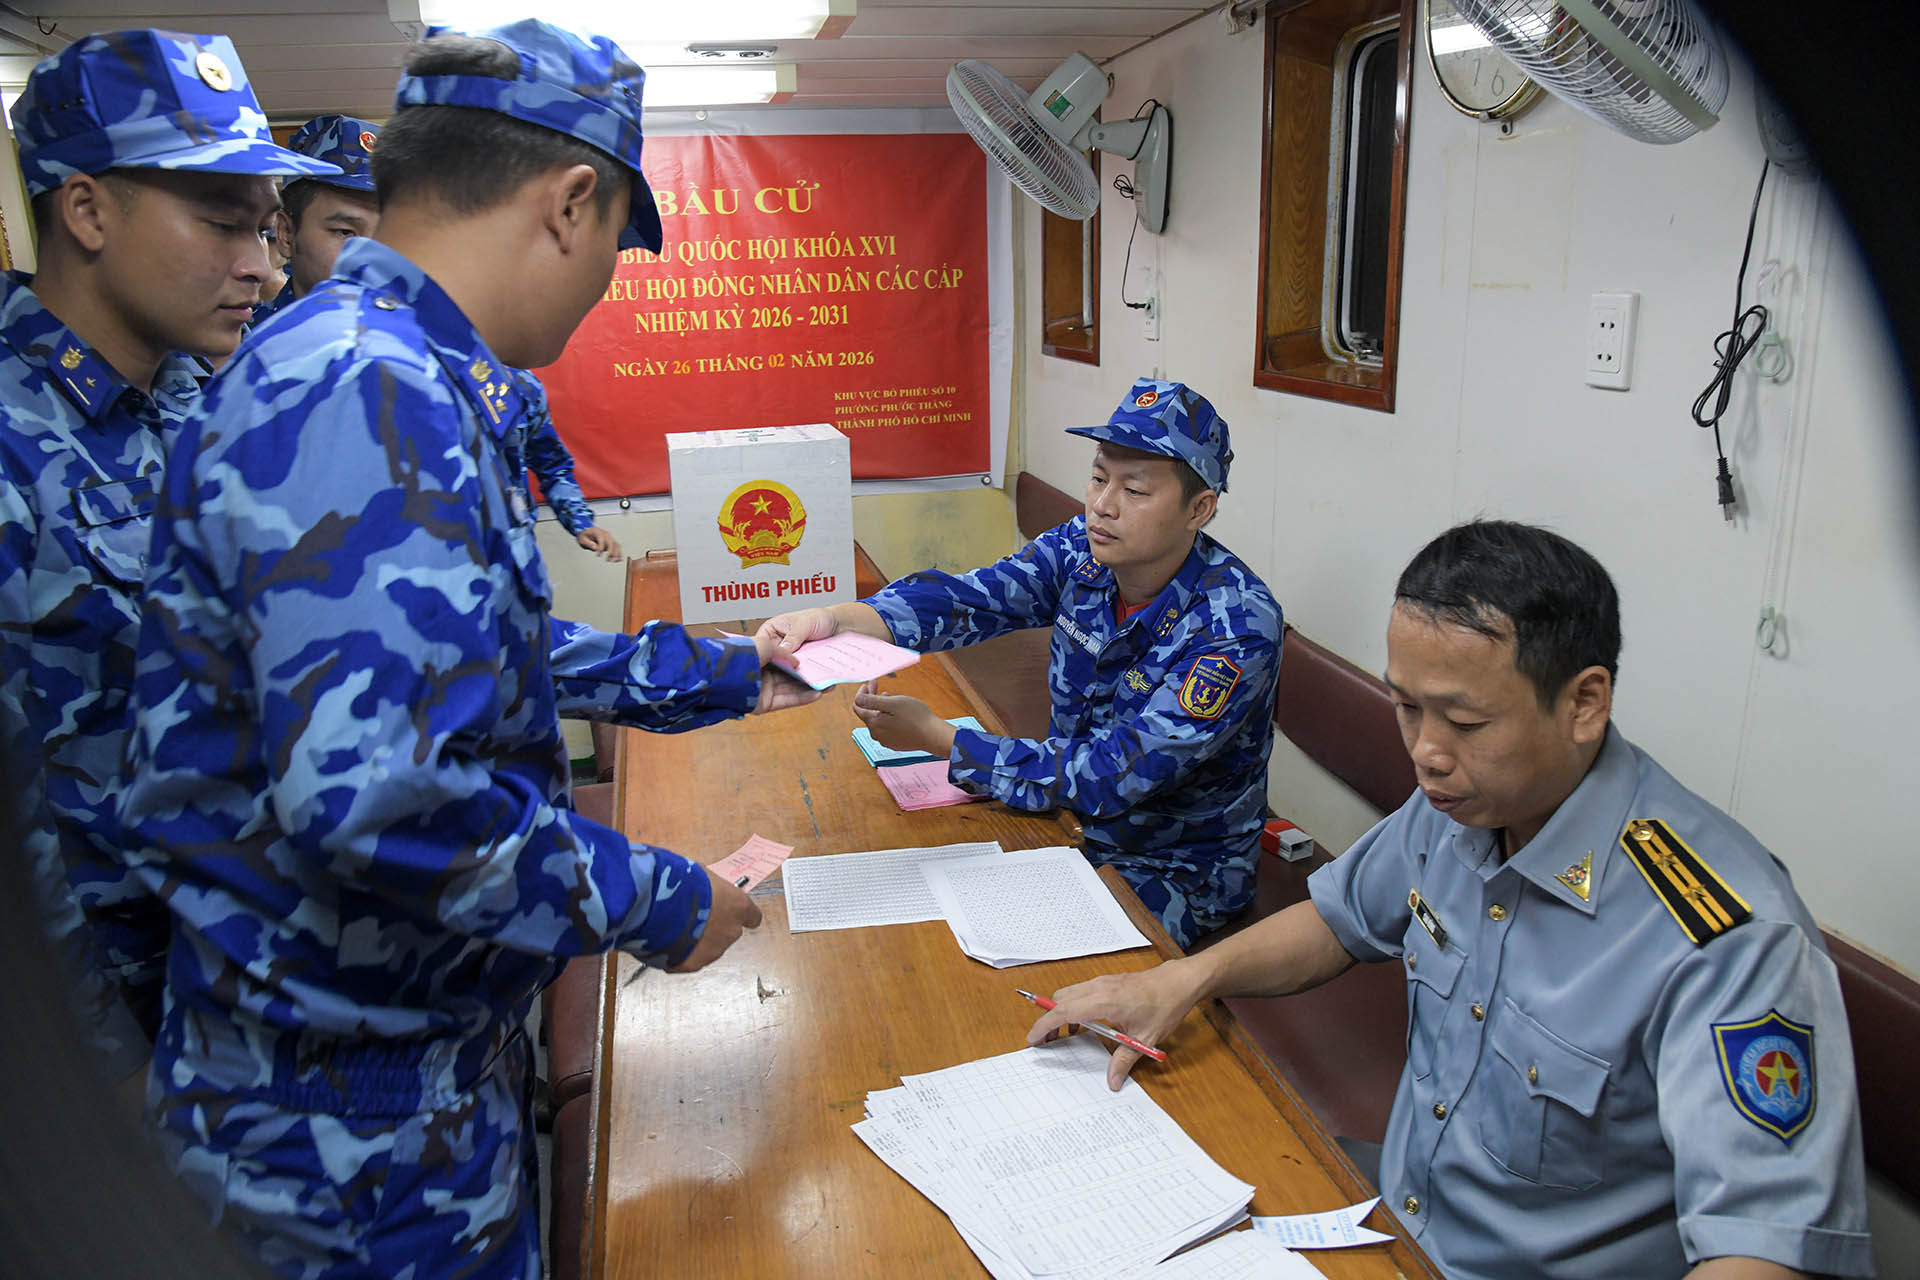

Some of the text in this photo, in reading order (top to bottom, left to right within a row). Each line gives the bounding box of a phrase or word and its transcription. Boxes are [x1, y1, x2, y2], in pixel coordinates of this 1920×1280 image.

[655, 179, 821, 216] BẦU CỬ
[678, 234, 742, 267] QUỐC
[747, 236, 787, 265] HỘI
[793, 231, 856, 259] KHÓA
[859, 235, 897, 257] XVI
[646, 275, 687, 305] HỘI
[692, 270, 756, 299] ĐỒNG
[760, 267, 821, 296] NHÂN
[827, 266, 871, 294] DÂN
[875, 264, 919, 292] CÁC
[924, 262, 964, 289] CẤP
[634, 307, 709, 337] NHIỆM
[714, 302, 745, 331] KỲ
[751, 306, 793, 329] 2026
[809, 304, 849, 327] 2031
[613, 349, 875, 378] NGÀY 26 THÁNG 02 NĂM 2026
[834, 391, 856, 401] KHU
[946, 386, 956, 395] 10
[943, 412, 971, 422] MINH
[701, 571, 836, 603] THÙNG PHIẾU
